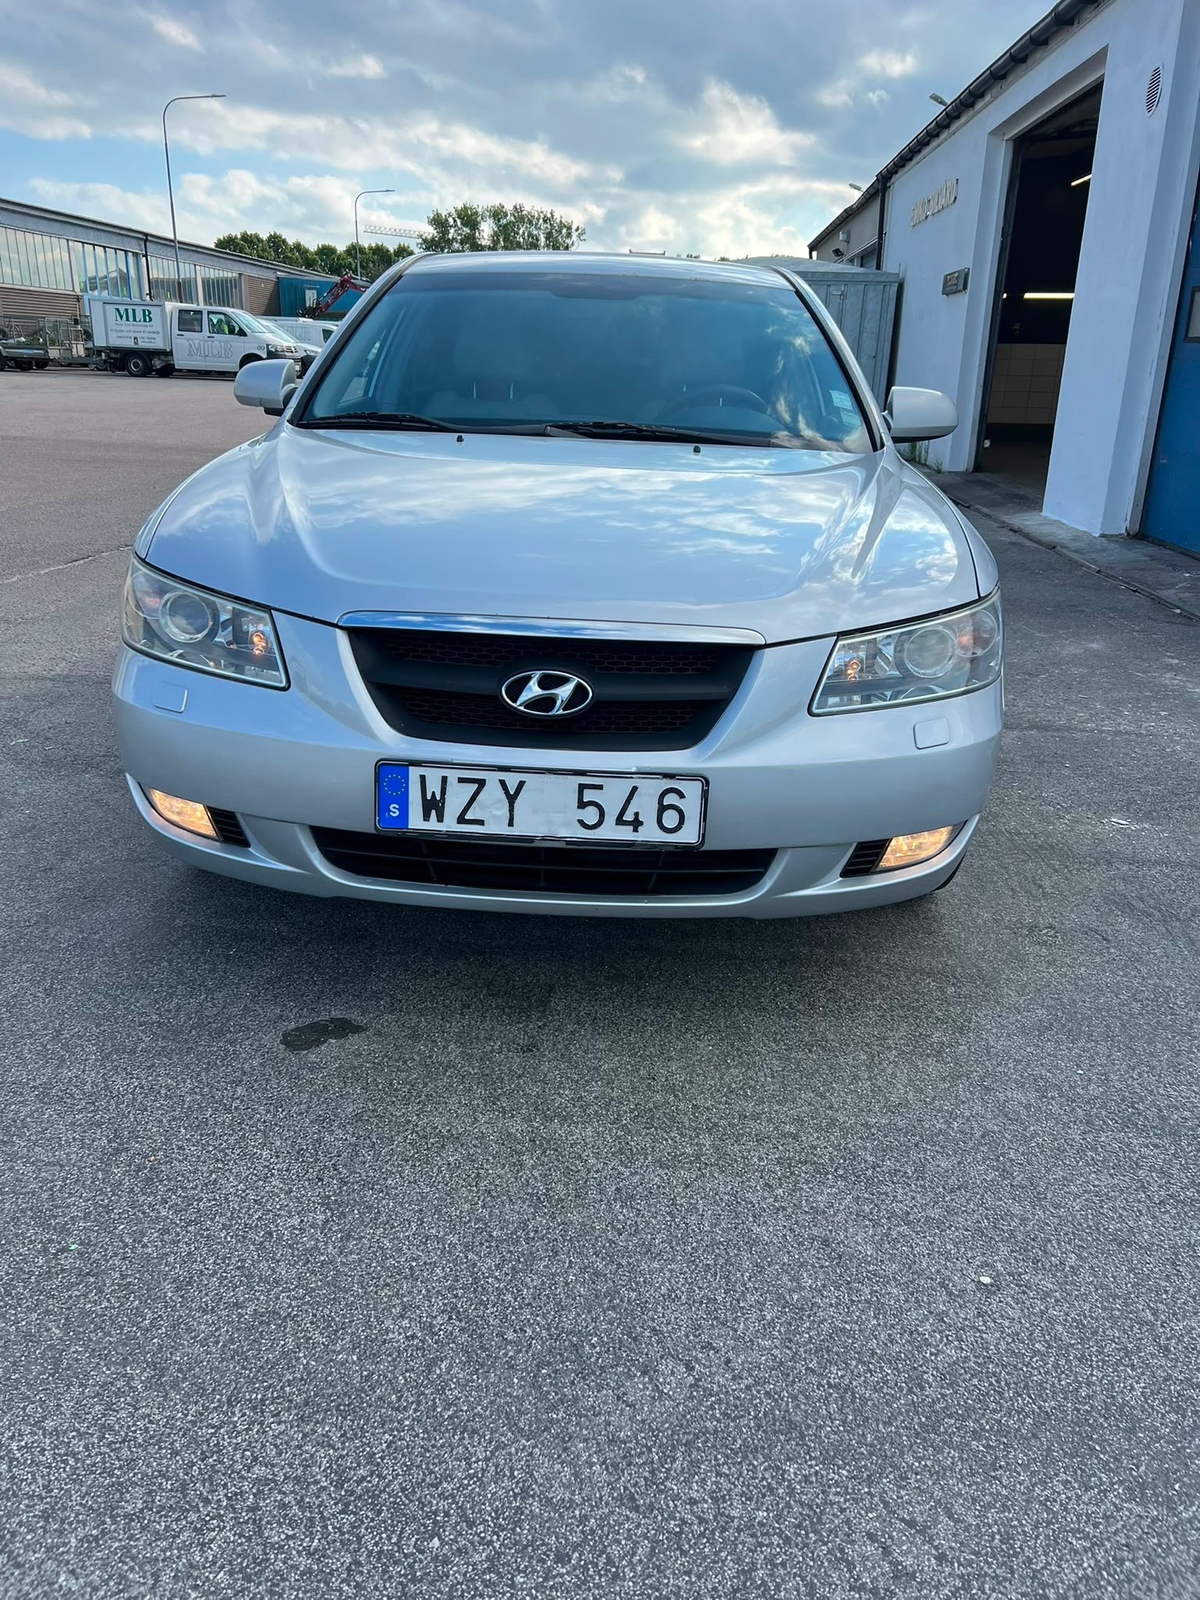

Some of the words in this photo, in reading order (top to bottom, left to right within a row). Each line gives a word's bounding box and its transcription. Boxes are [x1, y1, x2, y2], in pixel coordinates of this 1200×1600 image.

[114, 307, 153, 323] MLB
[187, 339, 234, 358] MLB
[388, 803, 400, 817] S
[419, 774, 526, 827] WZY
[576, 782, 687, 834] 546
